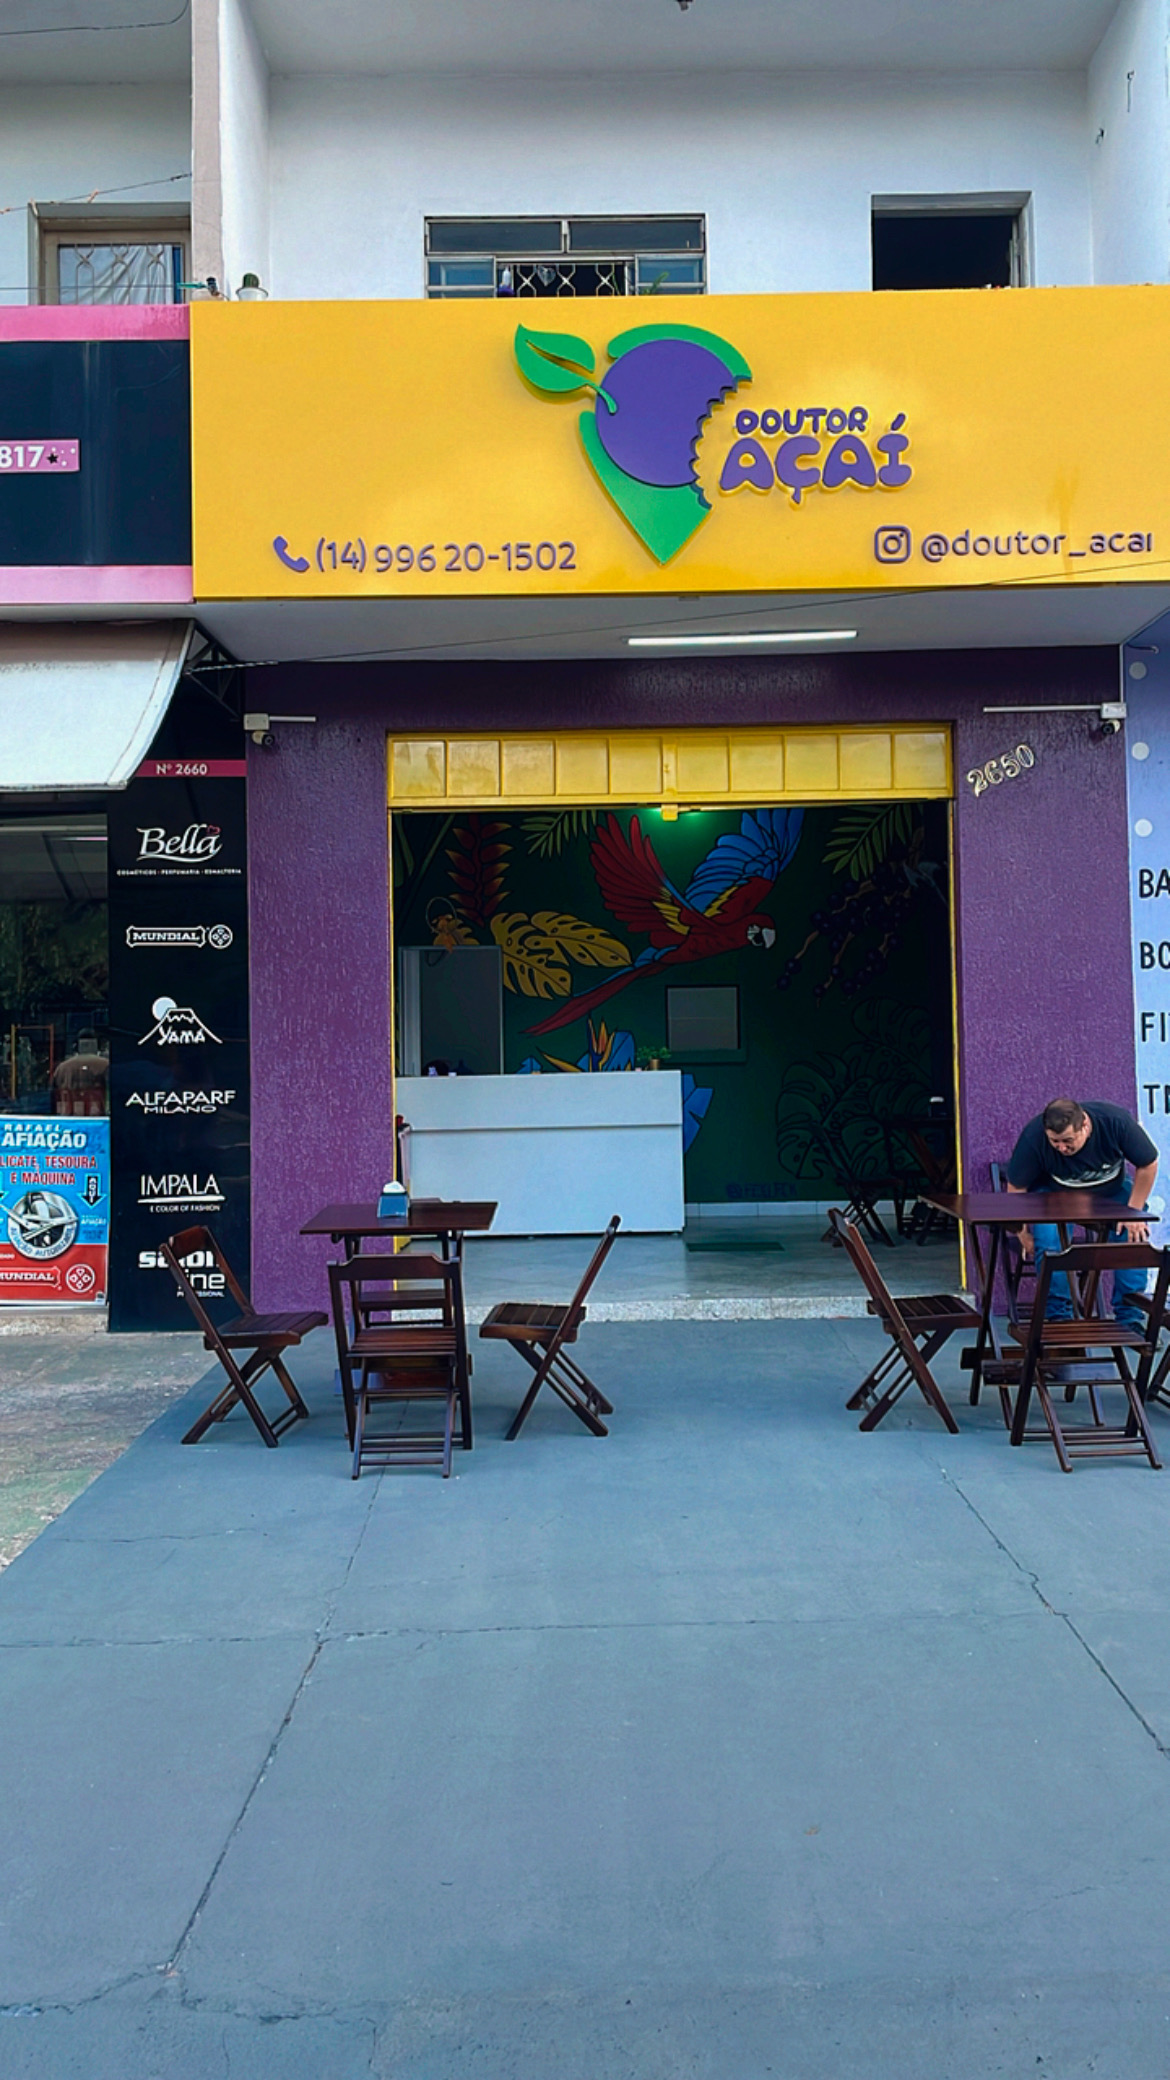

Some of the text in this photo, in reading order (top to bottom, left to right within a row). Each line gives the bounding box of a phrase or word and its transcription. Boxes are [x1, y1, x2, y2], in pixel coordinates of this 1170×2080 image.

[735, 406, 869, 435] DOUTOR
[0, 446, 44, 468] 817
[719, 412, 912, 504] AÇAÍ
[316, 537, 367, 573] (14)
[175, 763, 208, 775] 2660
[966, 744, 1034, 797] 2650
[136, 823, 223, 860] Bella
[132, 932, 201, 941] MUNDIAL
[157, 1026, 206, 1045] YAMA
[1141, 1012, 1170, 1042] FI
[125, 1090, 236, 1107] ALFAPARF
[144, 1105, 217, 1114] MILANO
[1, 1129, 87, 1153] AFIAÇÃO
[45, 1155, 98, 1169] TESOURA
[10, 1172, 17, 1185] E
[141, 1174, 220, 1196] IMPALA
[88, 1177, 97, 1204] AQUI
